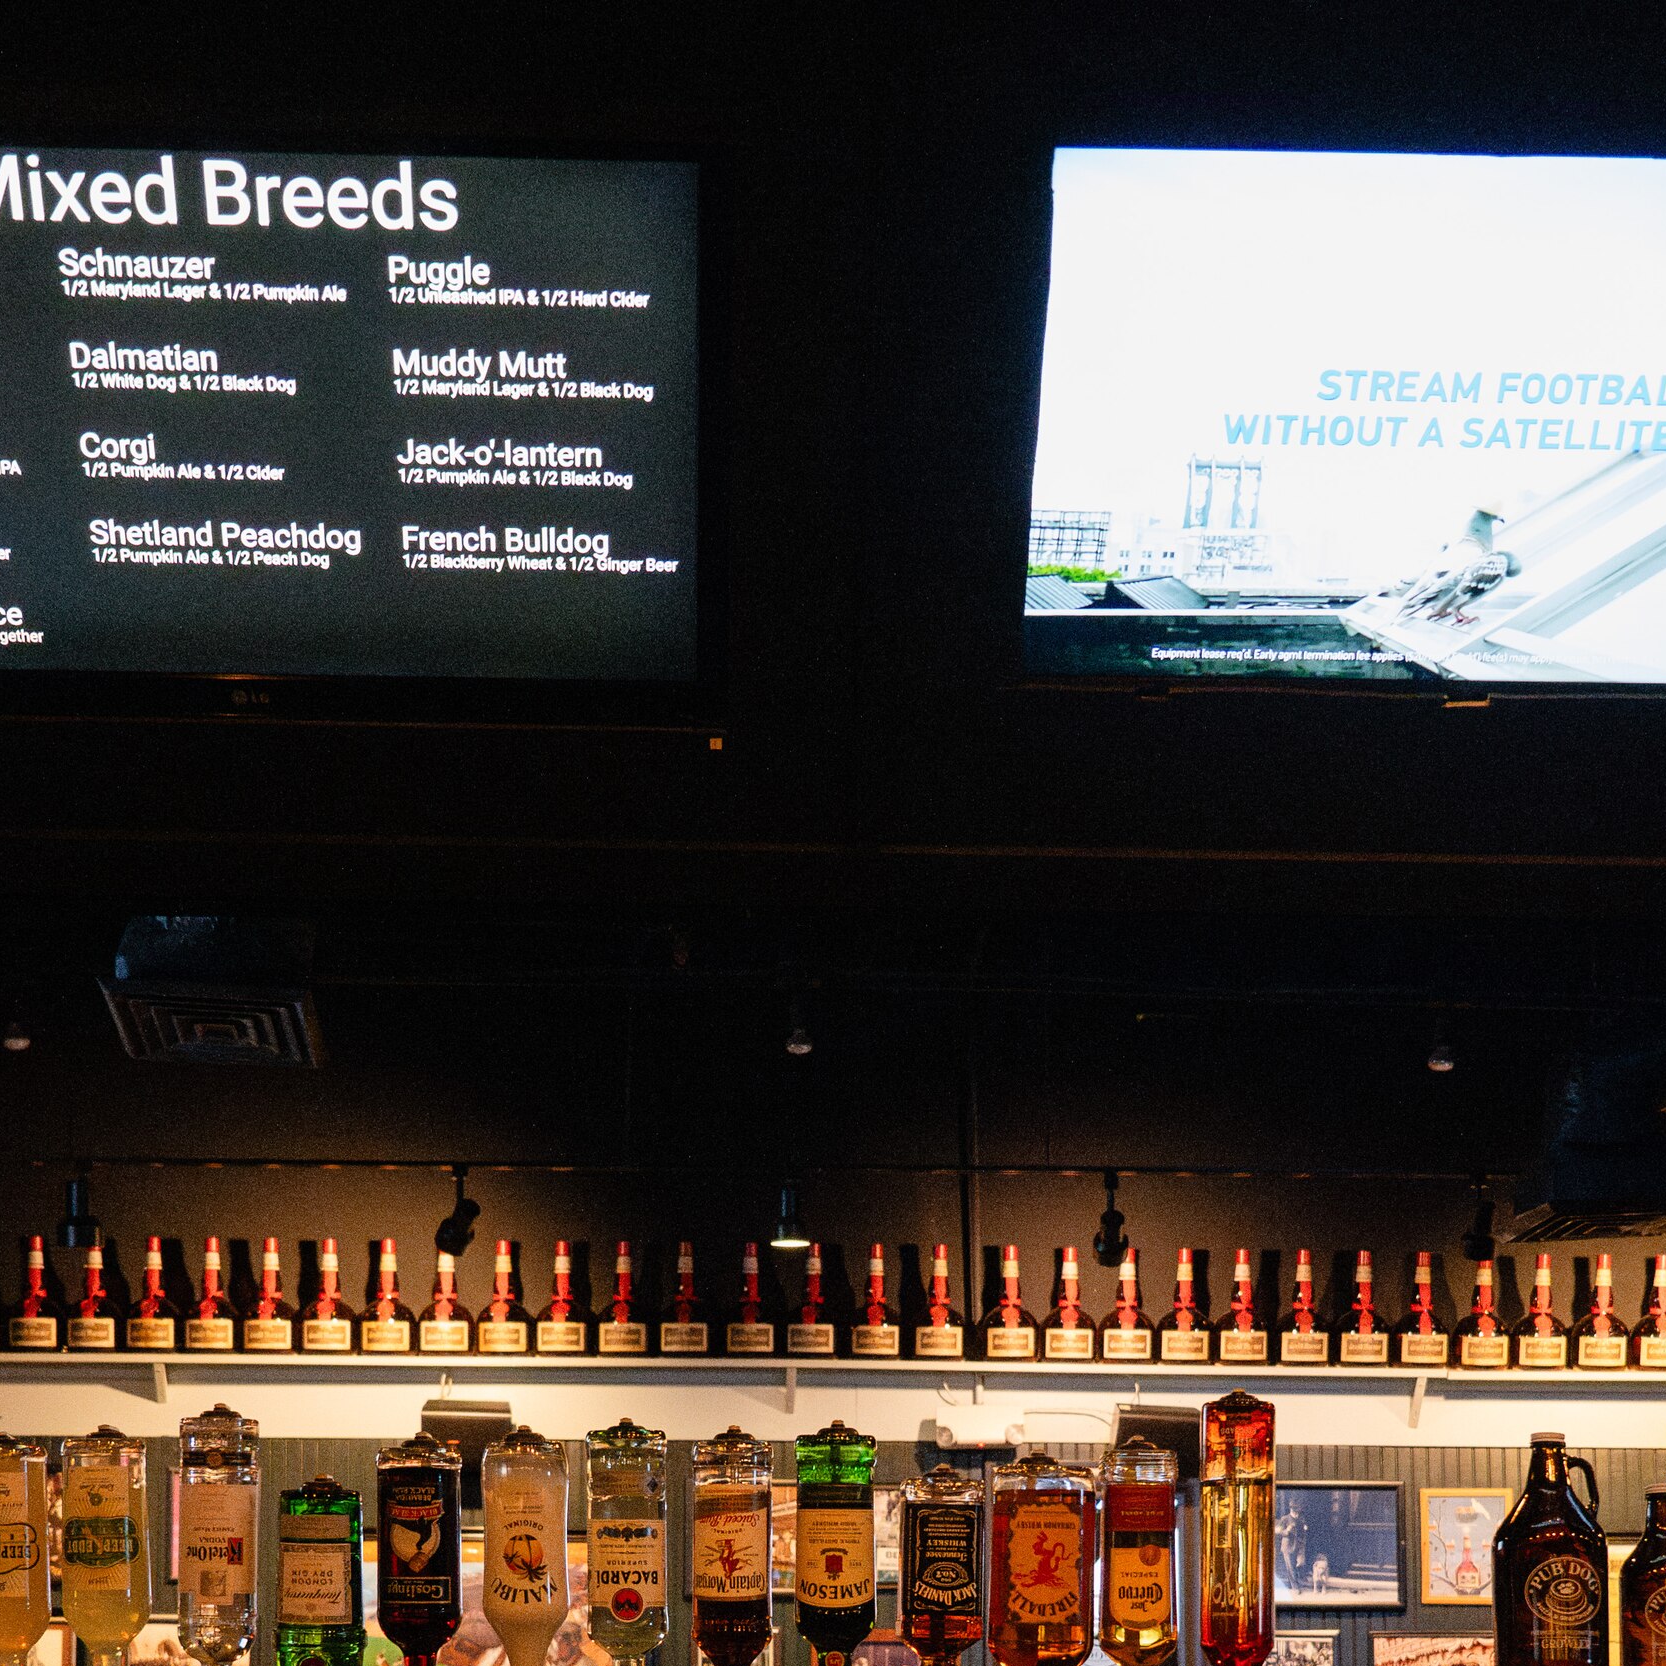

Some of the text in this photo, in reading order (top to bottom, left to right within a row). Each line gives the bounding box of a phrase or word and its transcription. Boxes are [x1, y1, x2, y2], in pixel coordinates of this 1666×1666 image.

[201, 159, 459, 232] Breeds
[1317, 369, 1483, 403] STREAM
[1224, 414, 1408, 446] WITHOUT
[1420, 417, 1444, 448] A
[396, 438, 603, 468] Jack-o'-lantern
[1152, 648, 1200, 660] Equipment
[1201, 649, 1225, 659] lease
[1254, 650, 1277, 661] Early
[1304, 651, 1355, 660] termination
[1356, 650, 1370, 660] fee
[1372, 651, 1404, 662] applies
[504, 1520, 544, 1531] ORIGINAL
[724, 1513, 759, 1527] Spiced
[186, 1537, 243, 1565] Ketel One
[925, 1550, 968, 1561] Tennessee
[291, 1577, 333, 1586] LONDON
[728, 1571, 765, 1592] Captain
[1530, 1561, 1599, 1591] PUB DOG
[283, 1589, 341, 1605] Tanqueray
[387, 1581, 443, 1599] Goslings
[491, 1576, 559, 1605] MALIBU
[799, 1578, 871, 1600] JAMESON
[914, 1580, 977, 1606] JACK DANIEL'S
[1118, 1583, 1163, 1602] Cuervo
[1012, 1591, 1078, 1617] FIREBALL
